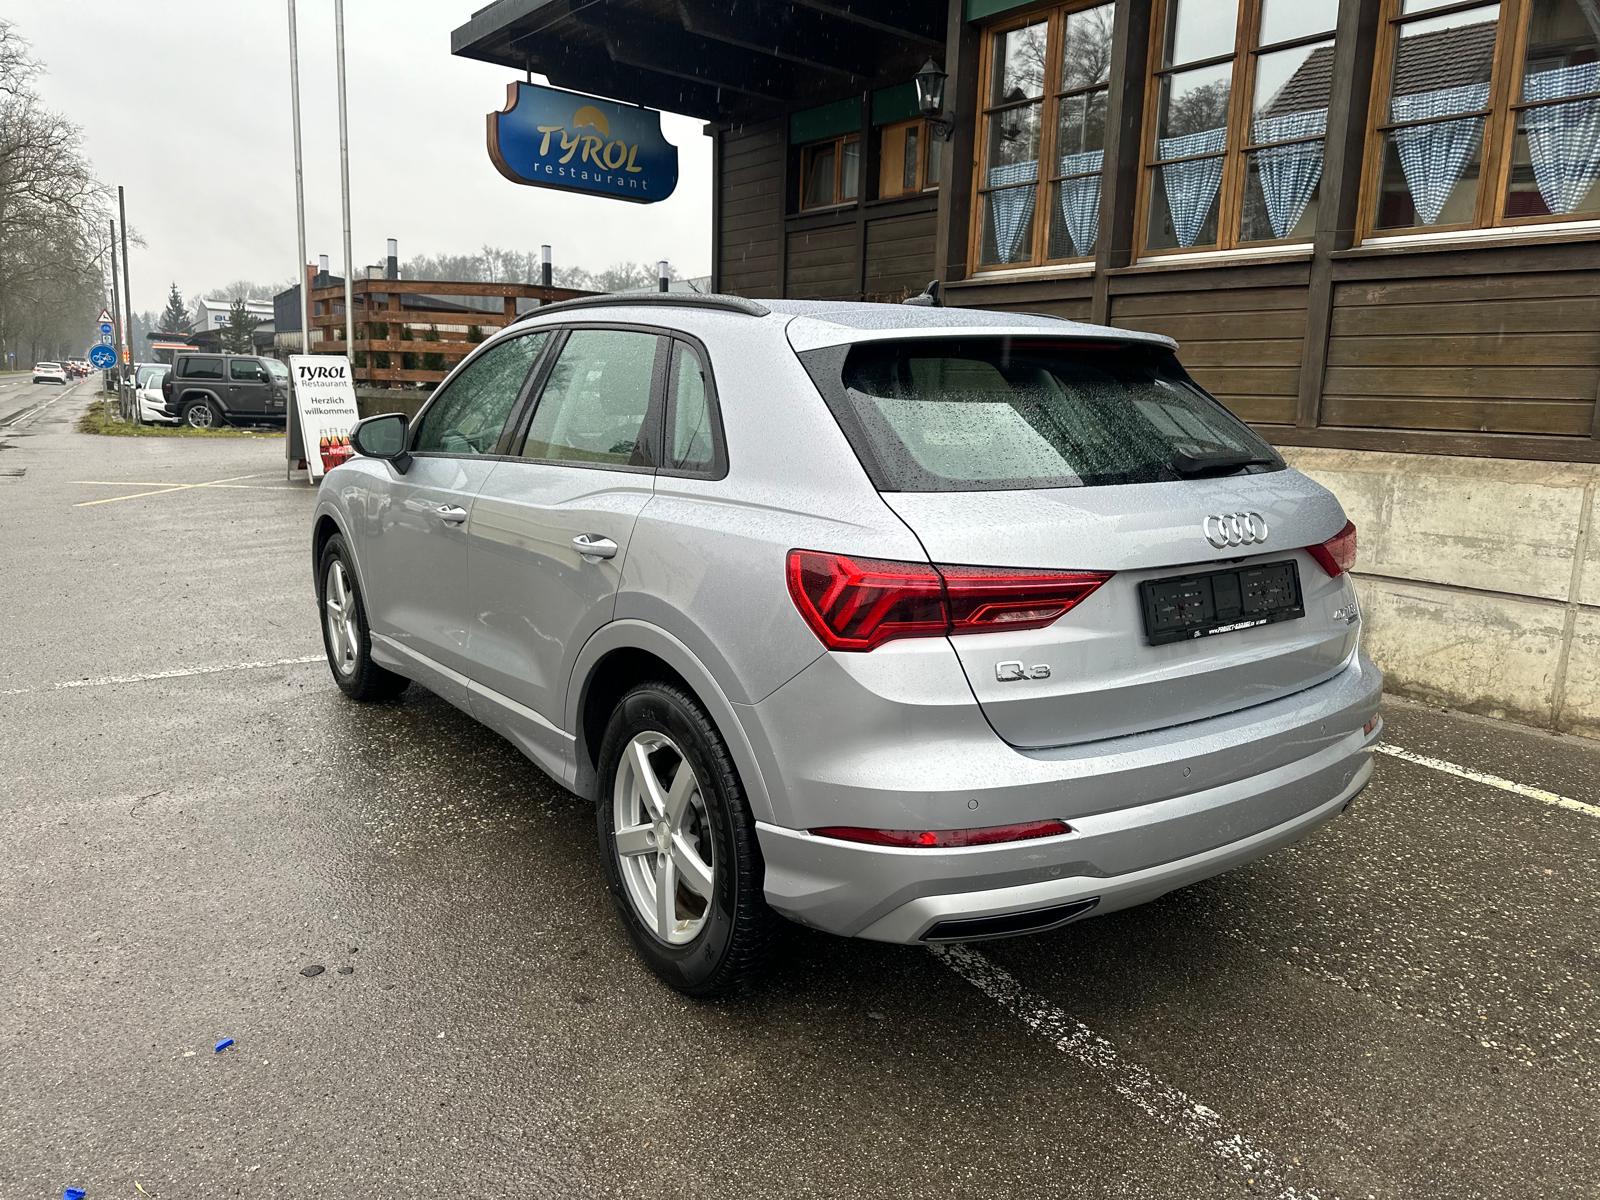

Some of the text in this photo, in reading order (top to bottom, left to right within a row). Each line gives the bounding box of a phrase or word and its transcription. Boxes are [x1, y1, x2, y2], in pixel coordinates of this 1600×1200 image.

[537, 126, 642, 173] TYROL
[534, 162, 648, 190] restaurant
[299, 367, 345, 380] TYROL
[995, 660, 1051, 682] Q3
